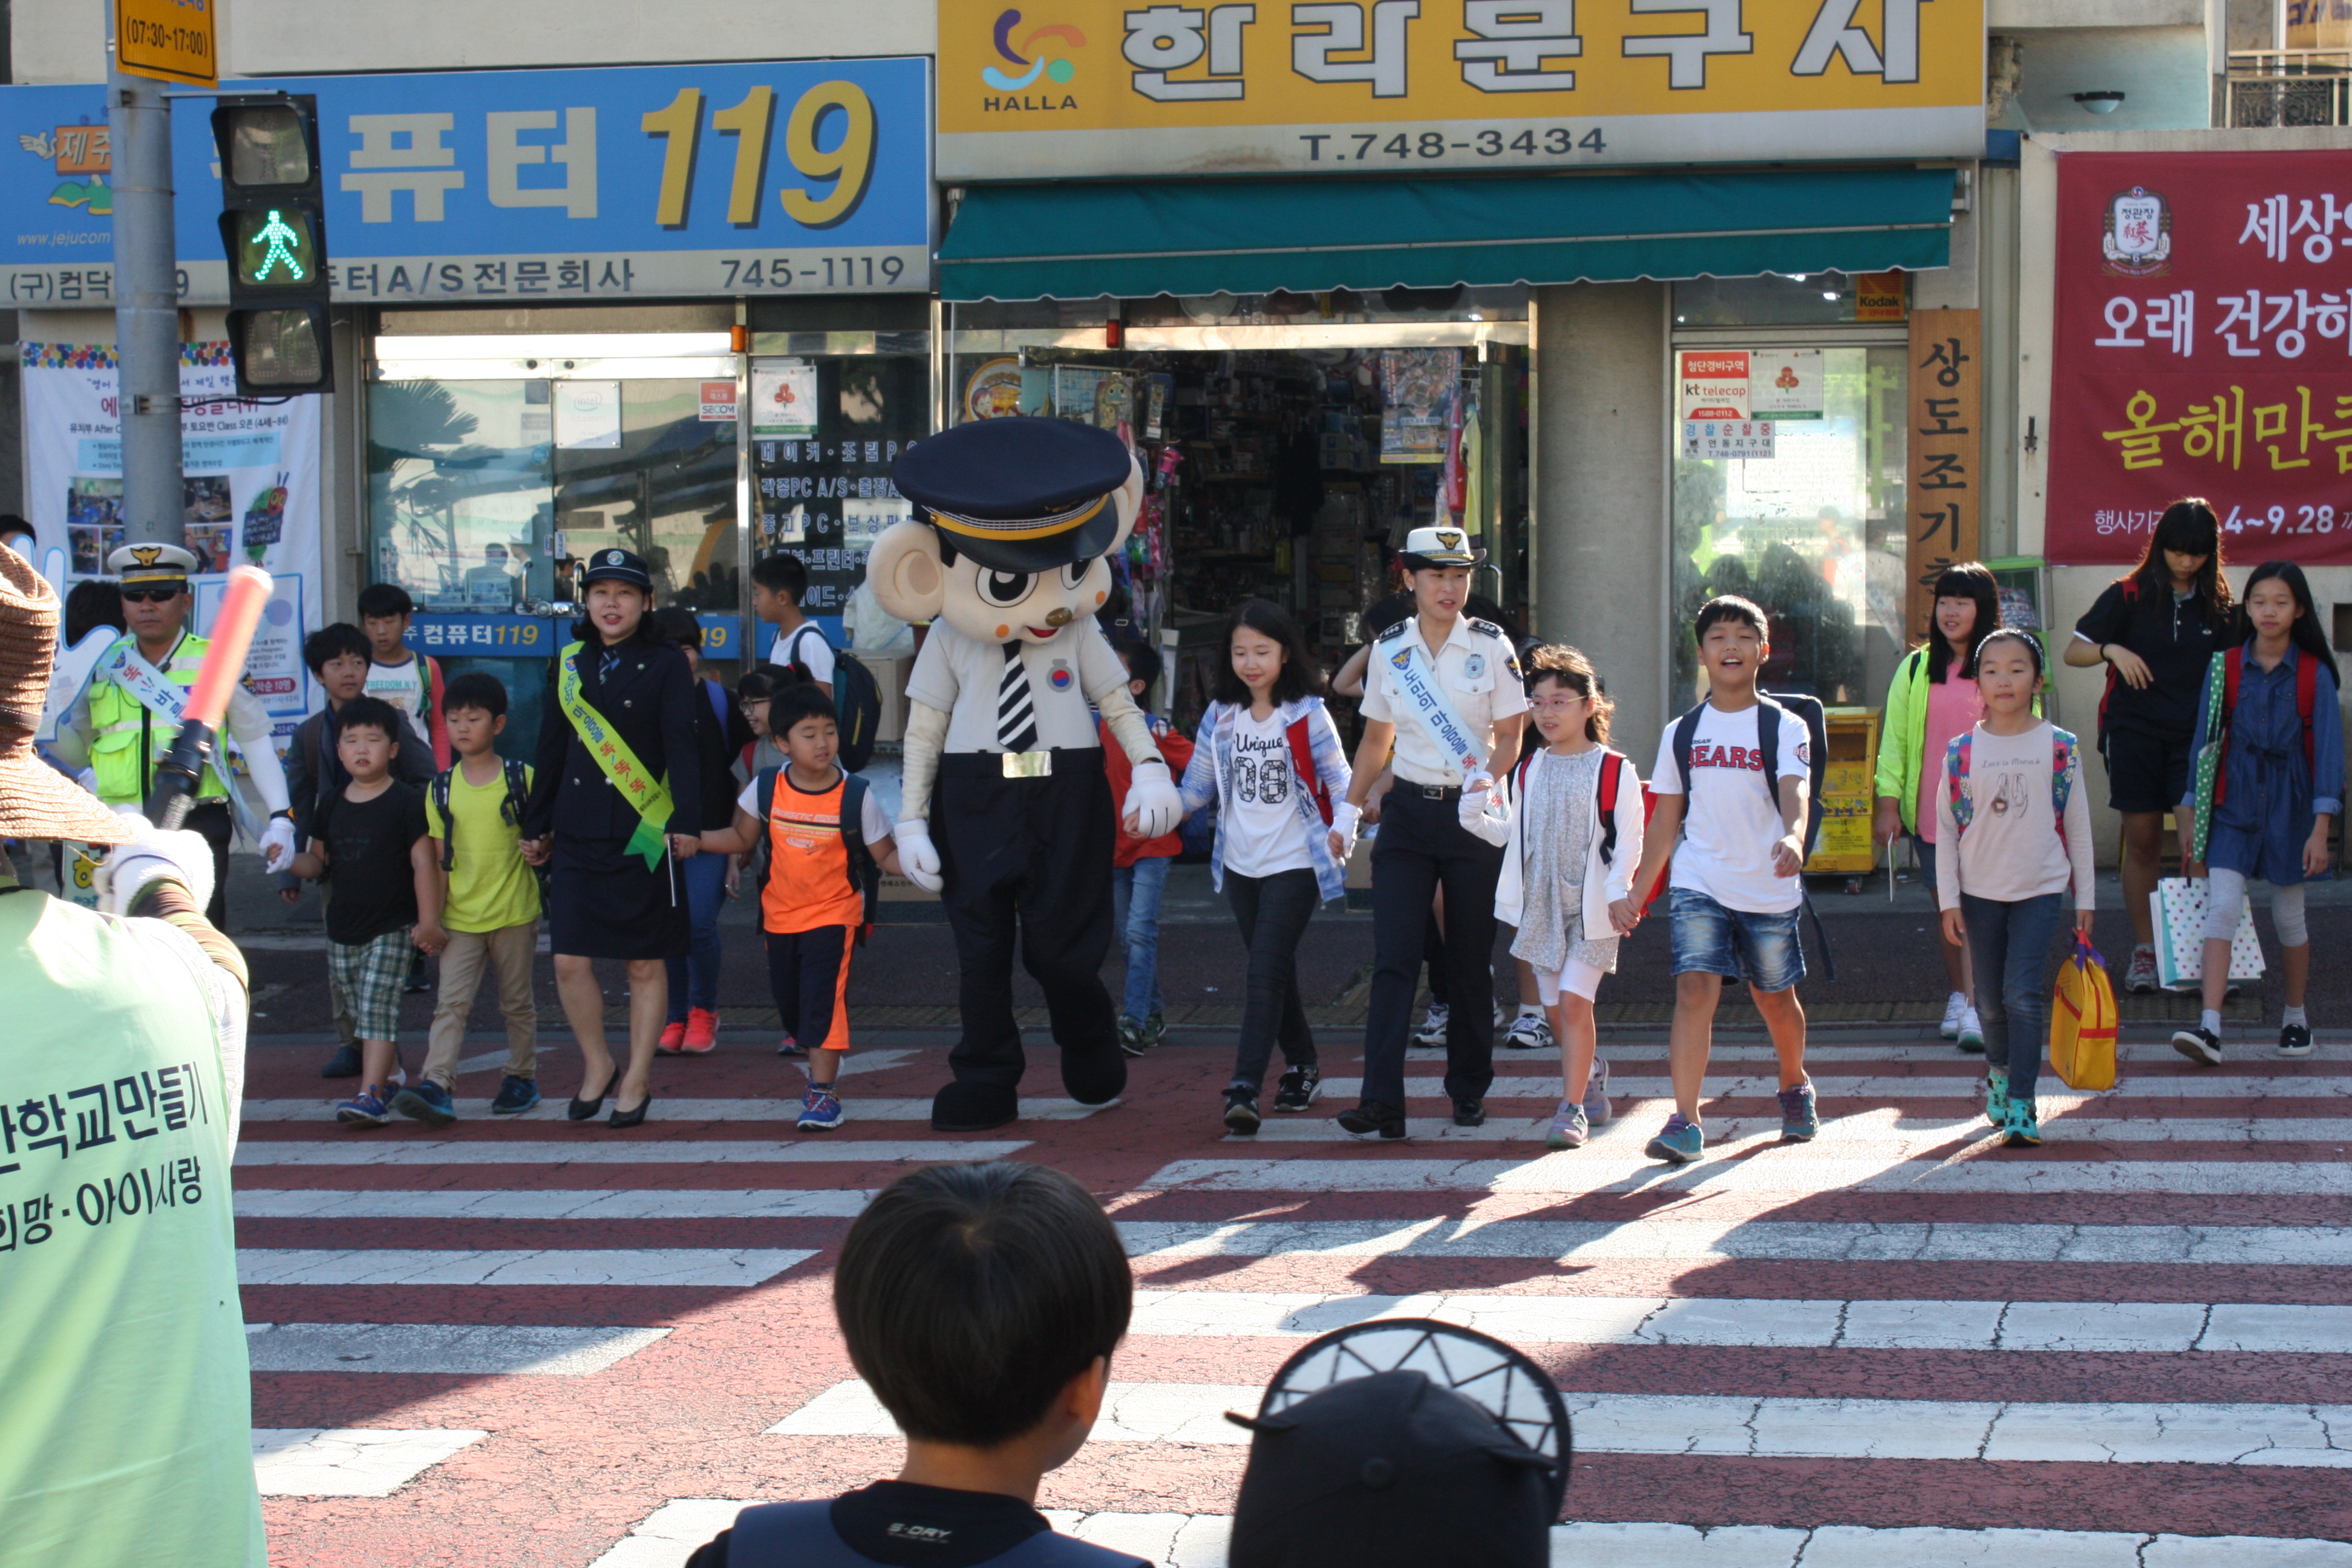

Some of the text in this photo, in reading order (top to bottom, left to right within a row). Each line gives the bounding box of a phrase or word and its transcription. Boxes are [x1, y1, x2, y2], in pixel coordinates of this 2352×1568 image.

[126, 16, 207, 59] (07:30~17:00)
[984, 95, 1077, 112] HALLA
[341, 80, 878, 230] 퓨터 119
[1299, 127, 1606, 162] T.748-3434
[2122, 207, 2154, 220] 정관장
[2132, 253, 2140, 263] 6
[721, 256, 904, 290] 745-1119
[1860, 296, 1900, 307] Kodak
[2096, 290, 2194, 357] 오래
[1686, 384, 1699, 396] kt
[702, 405, 734, 414] SECOM
[762, 477, 812, 498] 각종PC
[1403, 668, 1438, 712] 도민의
[1430, 710, 1469, 756] 마음을
[1233, 733, 1283, 758] Unique
[1235, 756, 1288, 805] 08
